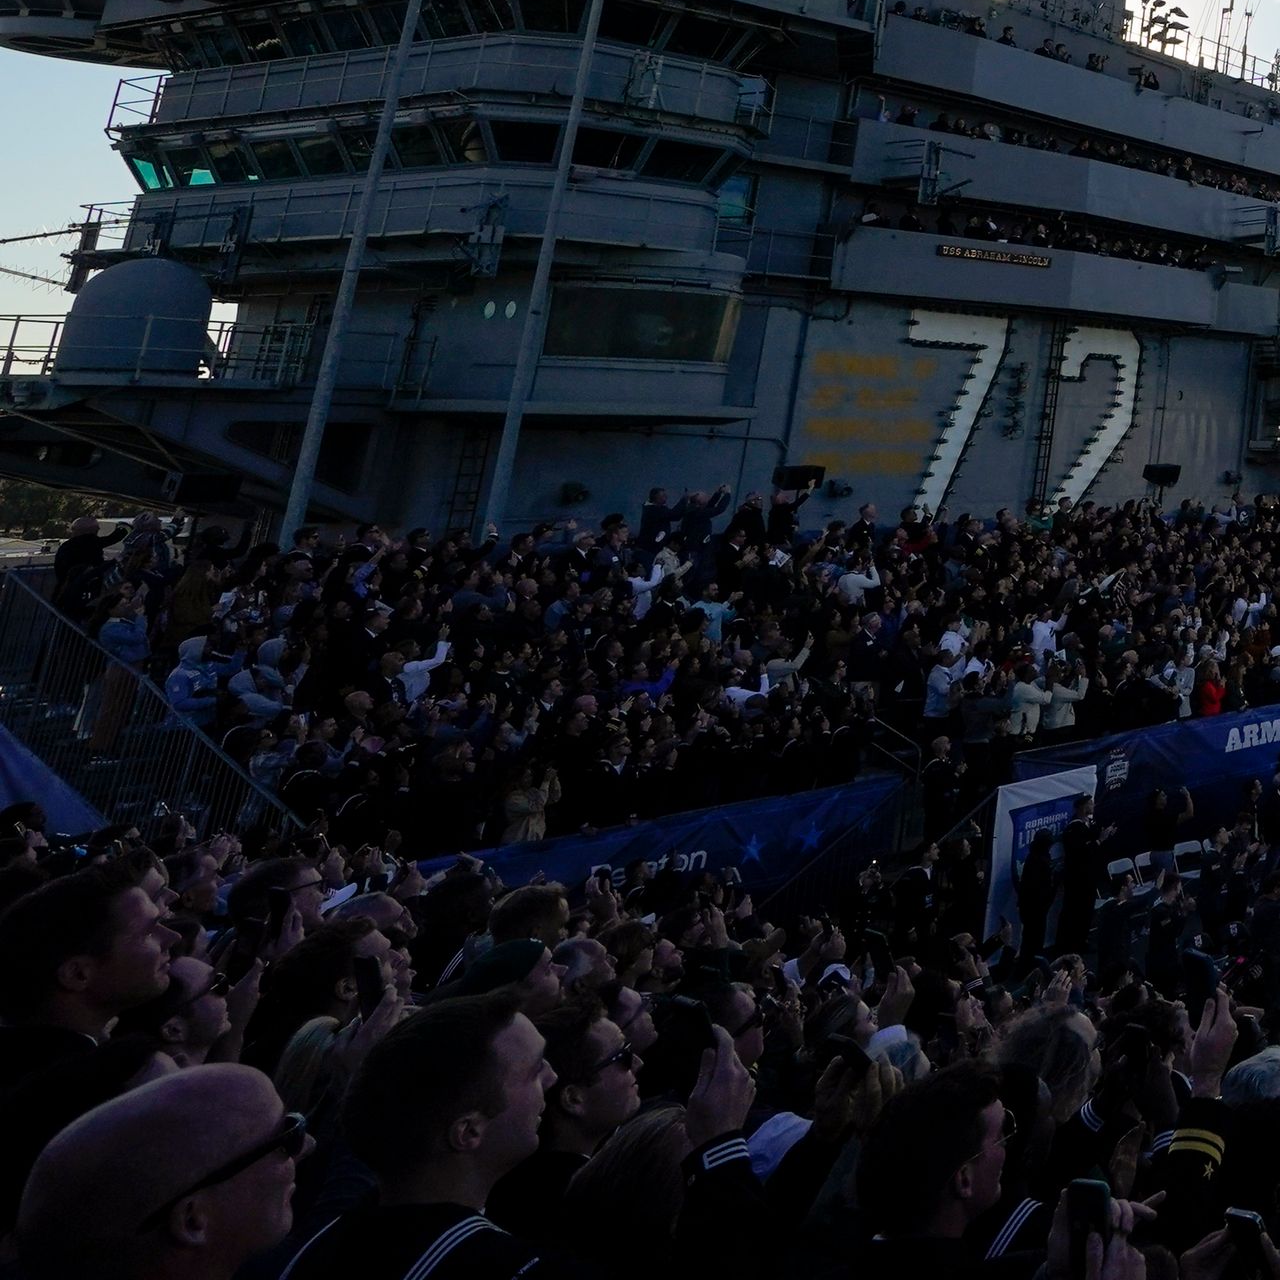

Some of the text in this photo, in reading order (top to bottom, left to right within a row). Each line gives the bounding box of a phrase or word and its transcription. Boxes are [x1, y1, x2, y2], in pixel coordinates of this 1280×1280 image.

[942, 246, 1050, 266] USS ABRAHAM LINCOLN
[908, 308, 1142, 522] 72
[1025, 811, 1069, 830] ABRAHAM
